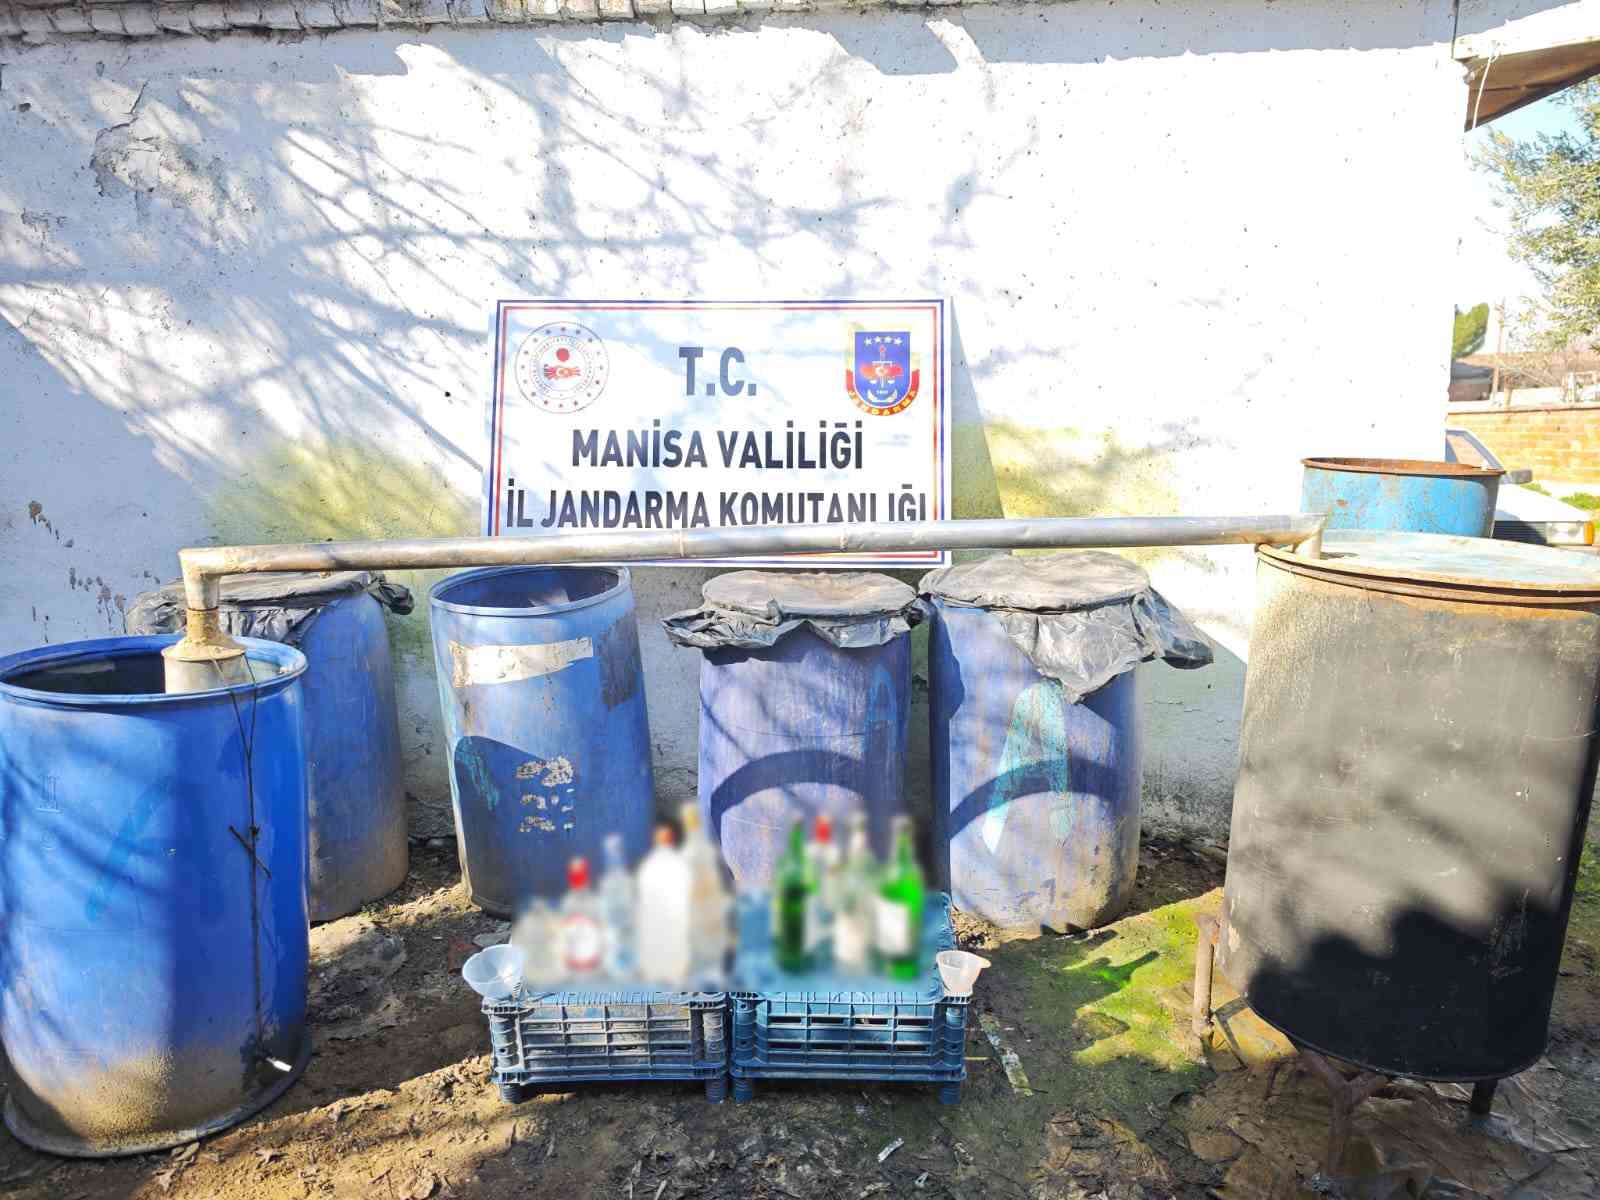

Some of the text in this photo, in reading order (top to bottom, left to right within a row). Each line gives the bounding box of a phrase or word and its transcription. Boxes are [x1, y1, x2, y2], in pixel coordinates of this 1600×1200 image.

[678, 346, 757, 396] T.C.
[572, 418, 863, 469] MANİSA VALİLİĞİ
[506, 478, 534, 528] İL
[540, 490, 711, 529] JANDARMA
